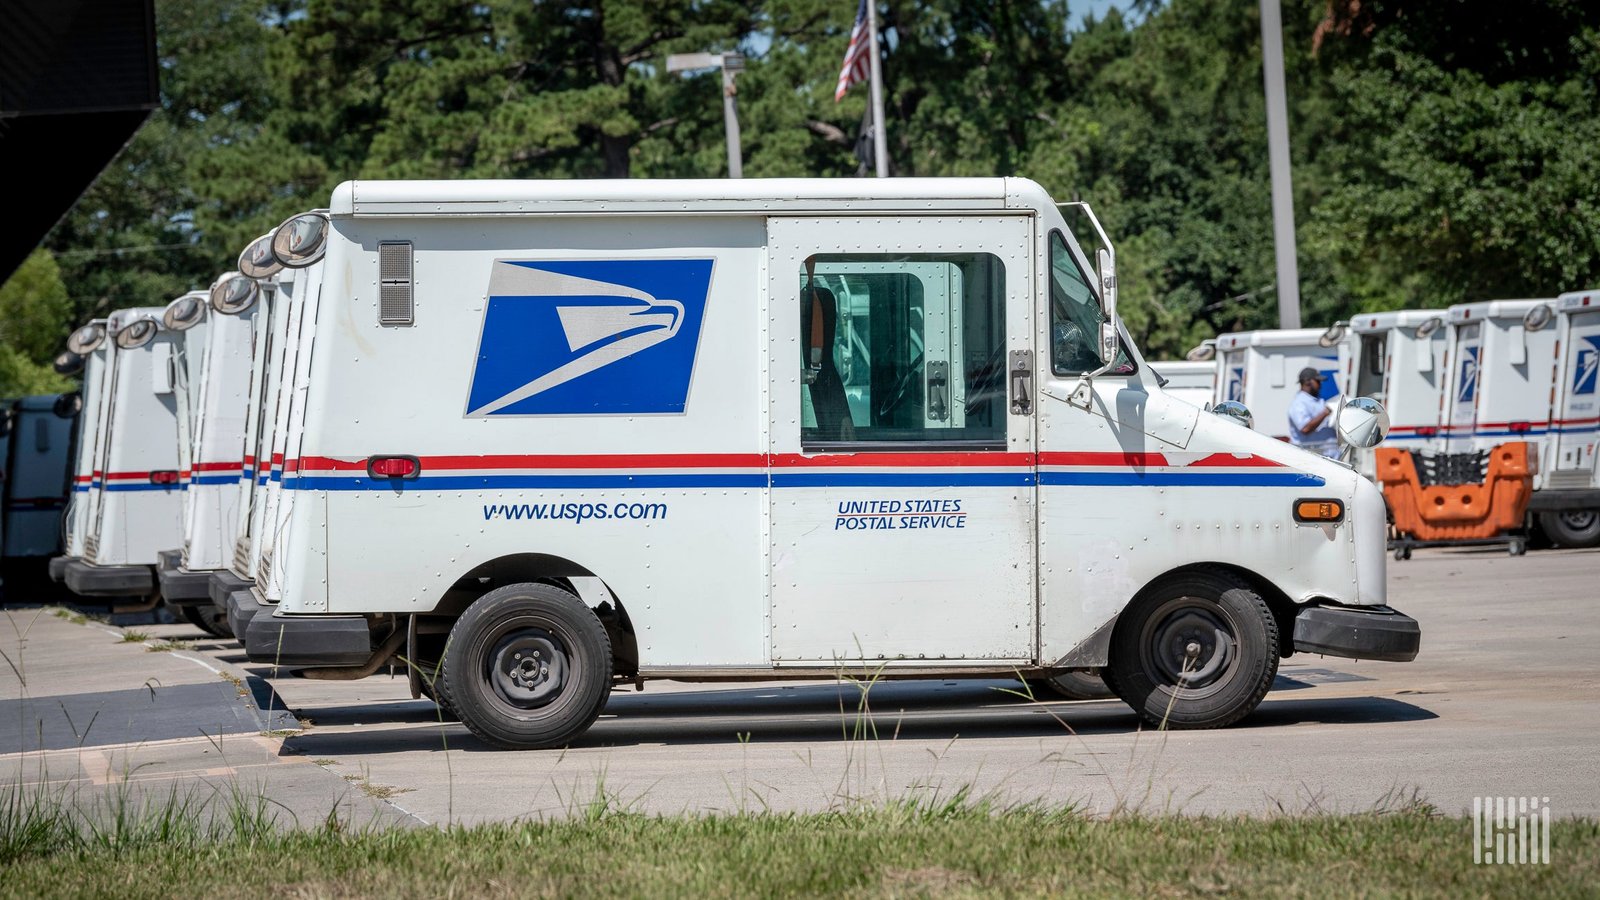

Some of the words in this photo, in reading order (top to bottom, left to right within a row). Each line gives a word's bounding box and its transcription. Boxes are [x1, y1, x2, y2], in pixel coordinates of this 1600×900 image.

[483, 502, 668, 525] www.usps.com
[838, 500, 902, 514] UNITED
[903, 499, 962, 513] STATES
[834, 516, 897, 531] POSTAL
[898, 515, 967, 529] SERVICE
